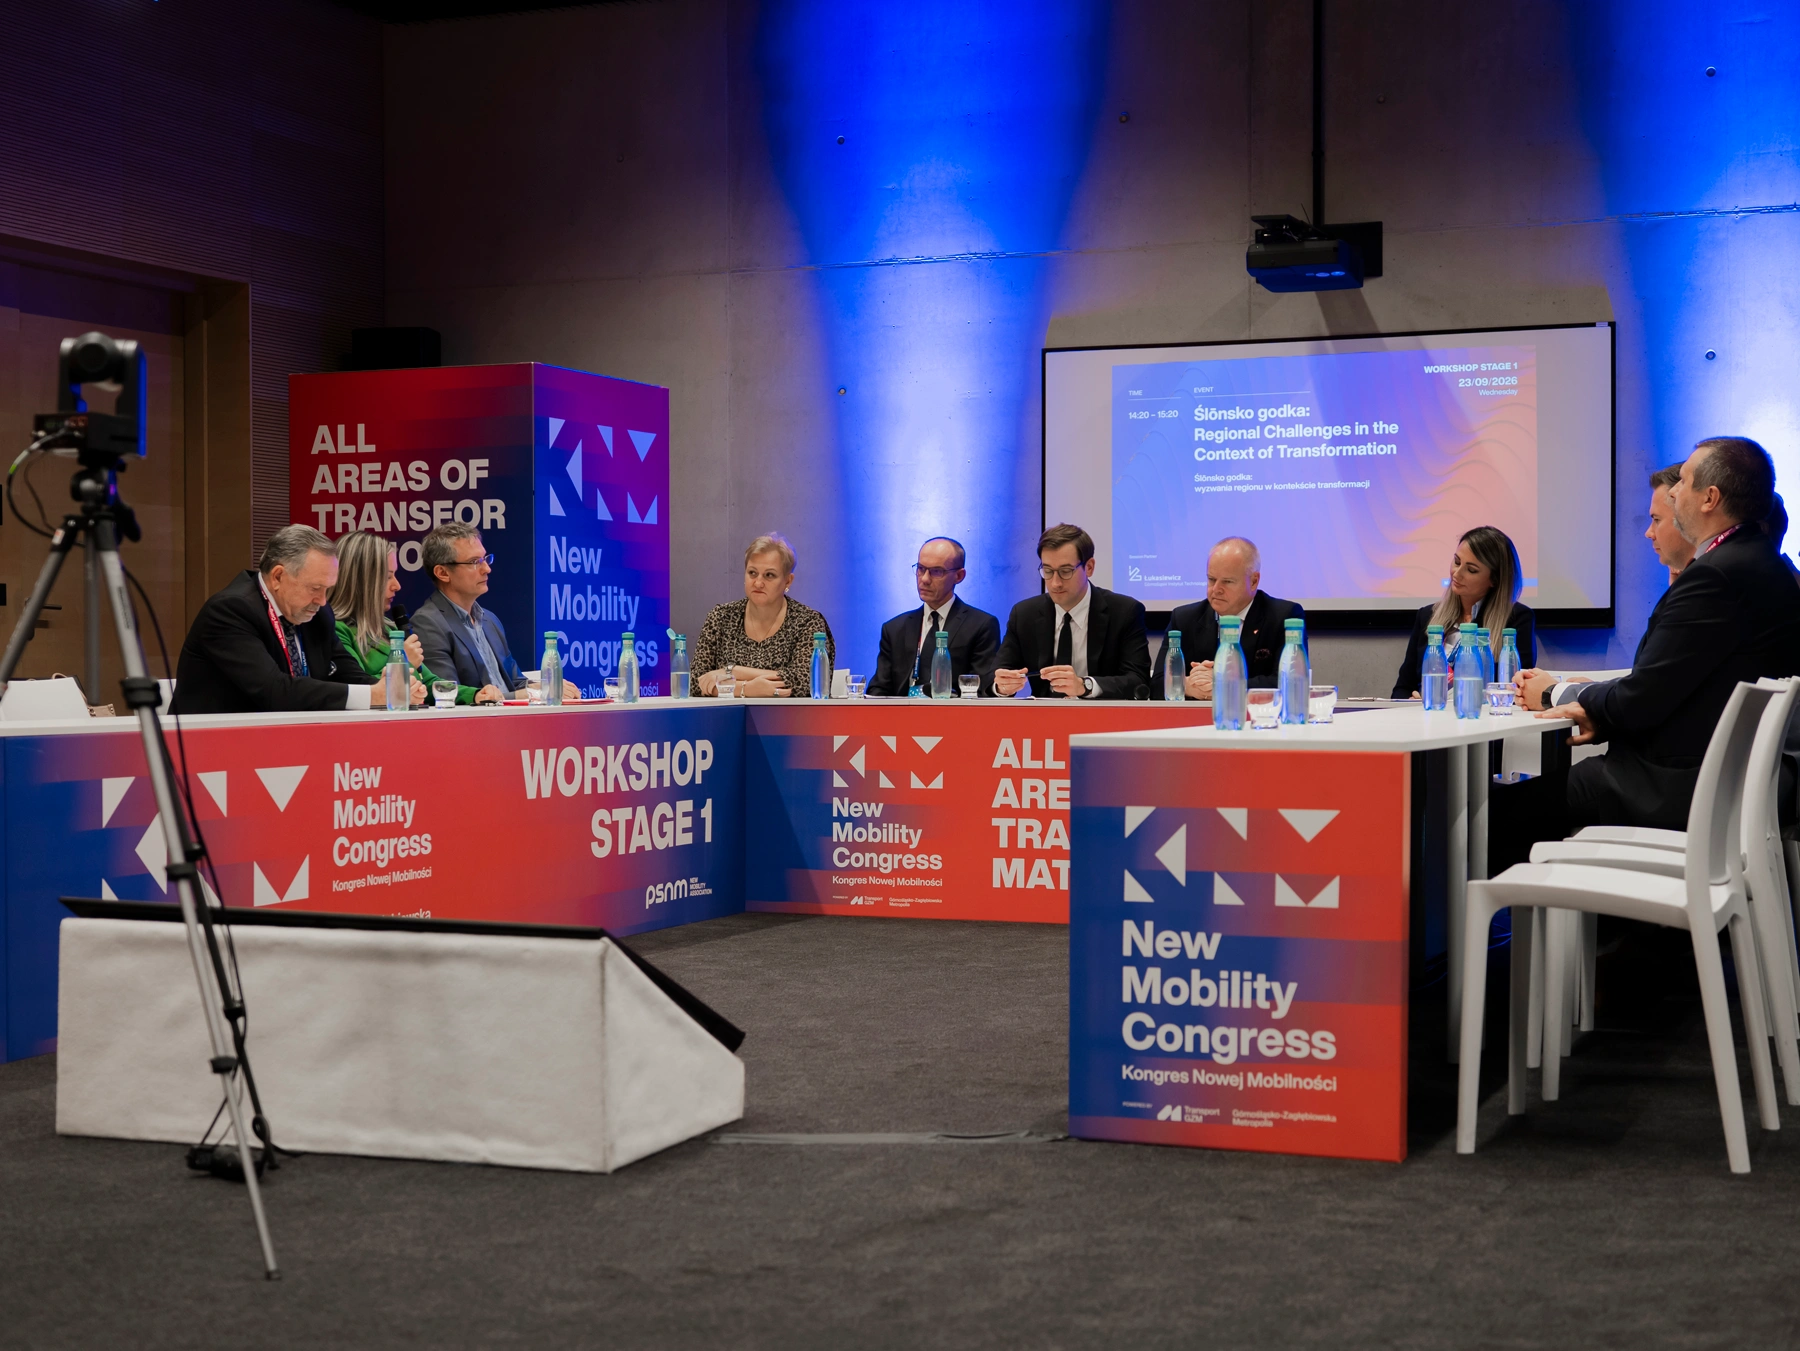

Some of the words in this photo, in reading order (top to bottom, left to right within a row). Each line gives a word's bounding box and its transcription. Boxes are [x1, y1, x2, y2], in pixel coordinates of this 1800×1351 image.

[1424, 364, 1478, 374] WORKSHOP
[1481, 362, 1511, 371] STAGE
[1513, 362, 1518, 370] 1
[1458, 376, 1518, 388] 23/09/2026
[1479, 388, 1518, 397] Wednesday
[1129, 411, 1150, 420] 14:20
[1157, 410, 1179, 419] 15:20
[1258, 404, 1310, 422] godka:
[311, 423, 376, 455] ALL
[1194, 426, 1260, 444] Regional
[1264, 423, 1351, 440] Challenges
[1355, 422, 1369, 435] in
[1373, 421, 1399, 434] the
[1194, 447, 1254, 461] Context
[1258, 446, 1273, 459] of
[1277, 442, 1397, 458] Transformation
[311, 460, 430, 494] AREAS
[440, 459, 489, 490] OF
[1194, 485, 1233, 494] wyzwania
[1234, 484, 1264, 493] regionu
[1274, 481, 1316, 490] kontekście
[1318, 480, 1370, 489] transformacji
[1226, 473, 1253, 483] godka:
[311, 499, 506, 533] TRANSFOR
[550, 535, 602, 574] New
[550, 583, 639, 630] Mobility
[556, 631, 659, 677] Congrss
[992, 738, 1065, 769] ALL
[334, 762, 382, 792] New
[521, 739, 714, 799] WORKSHOP
[833, 797, 884, 817] New
[991, 778, 1070, 810] ARE
[333, 795, 416, 829] Mobility
[591, 801, 693, 859] STAGE
[700, 798, 713, 843] 1
[833, 822, 923, 849] Mobility
[991, 818, 1070, 850] TRA
[333, 833, 432, 868] Congress
[833, 847, 943, 874] Congress
[332, 880, 366, 893] Kongres
[366, 872, 391, 887] Nowej
[392, 866, 432, 883] Mobilności
[832, 876, 867, 886] Kongres
[869, 876, 895, 888] Nowej
[897, 877, 942, 887] Mobilności
[993, 858, 1070, 890] MAT
[645, 878, 688, 910] psnm
[1122, 919, 1222, 960] New
[1122, 966, 1298, 1019] Mobility
[1122, 1012, 1337, 1065] Congress
[1121, 1064, 1189, 1086] Kongres
[1192, 1069, 1244, 1091] Nowej
[1247, 1072, 1337, 1092] Mobilności
[1184, 1105, 1220, 1116] Transport
[1184, 1115, 1203, 1124] GZM
[1232, 1117, 1273, 1128] Metropolia
